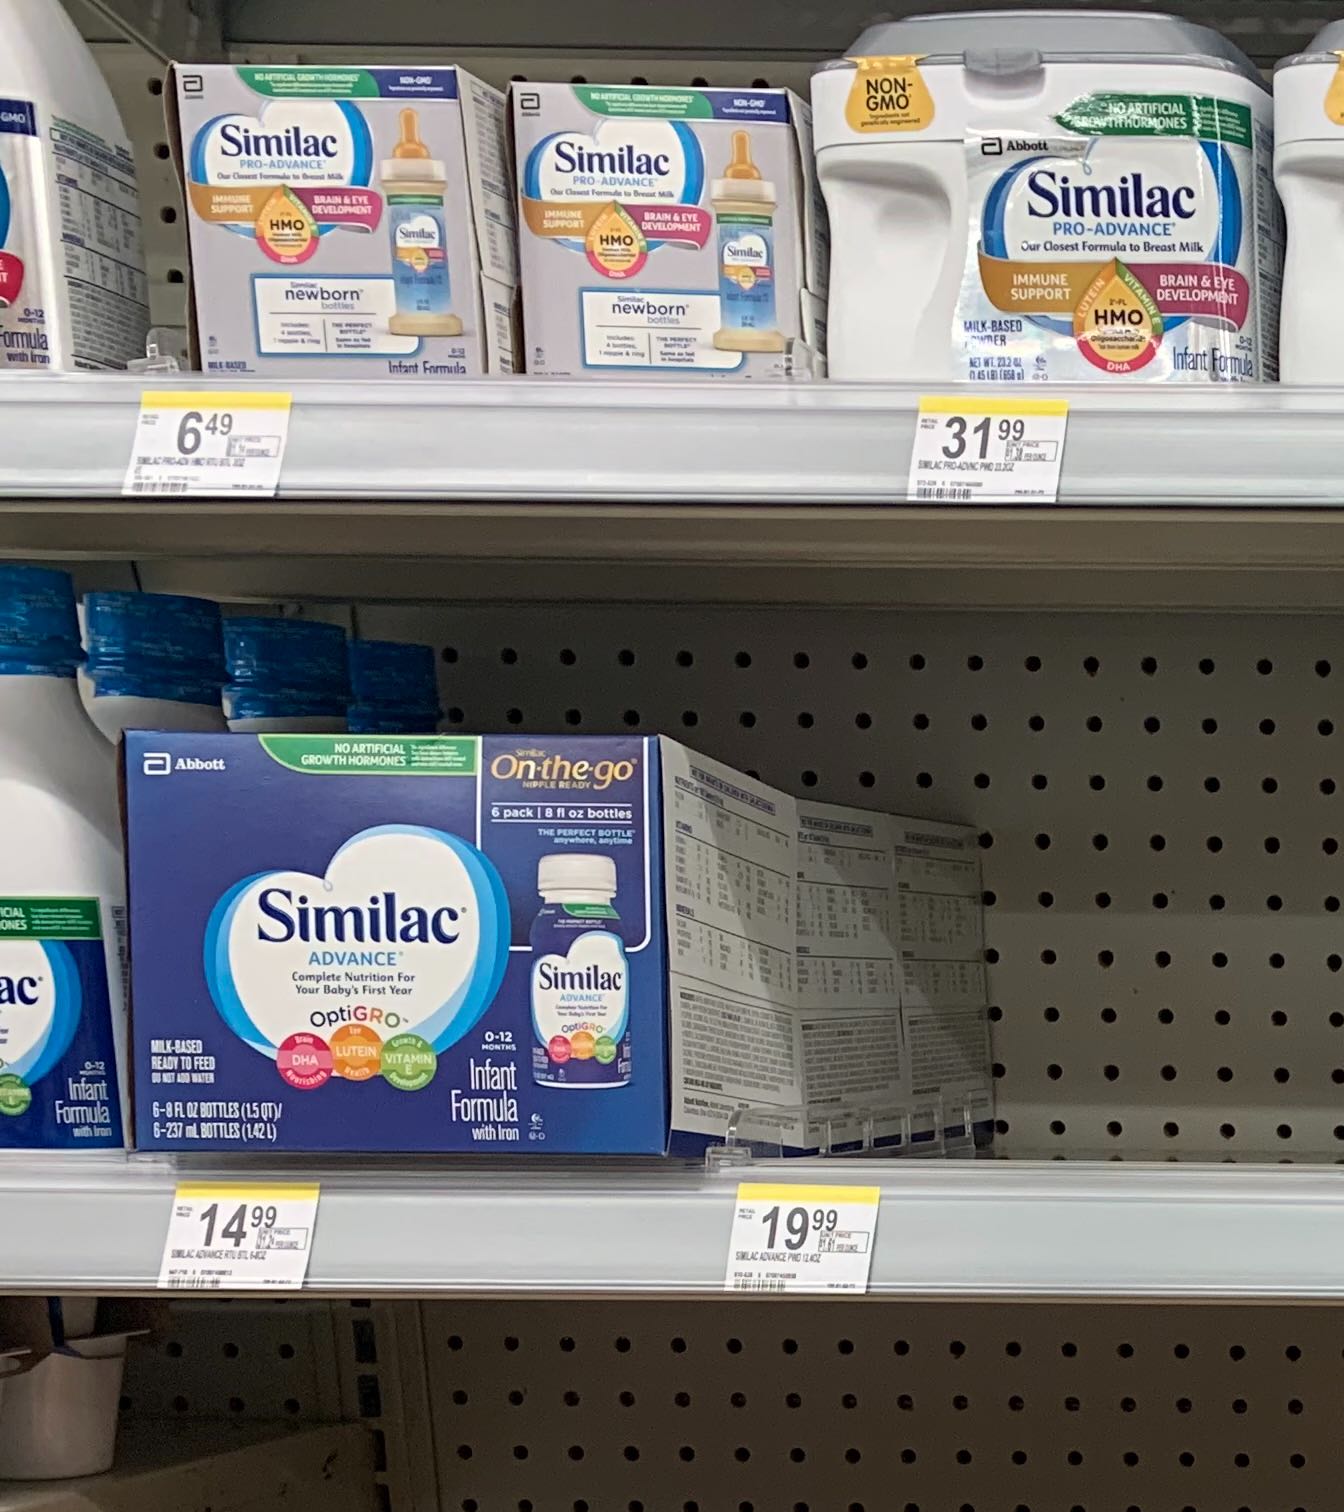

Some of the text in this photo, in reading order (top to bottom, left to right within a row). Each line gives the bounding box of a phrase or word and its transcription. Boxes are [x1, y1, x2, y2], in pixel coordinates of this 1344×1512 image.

[866, 78, 912, 95] NON-
[220, 124, 338, 159] Similac
[1007, 140, 1048, 152] Abbott
[240, 158, 325, 171] PRO-ADVANCE
[1028, 171, 1196, 219] Similac
[1054, 222, 1172, 237] PRO-ADVANCE
[599, 234, 634, 248] HMO
[1021, 240, 1203, 253] Our Closest Formula to Breast Milk
[1013, 274, 1068, 286] IMMUNE
[284, 287, 359, 303] newborn
[1011, 288, 1071, 300] SUPPORT
[1094, 310, 1143, 325] HMO
[1107, 361, 1131, 372] DHA
[175, 757, 225, 771] Abbott
[491, 806, 632, 821] 6 pack 8 fl oz bottles
[257, 889, 460, 944] Similac
[309, 951, 397, 967] ADVANCE
[296, 984, 413, 998] Your Baby's First Year
[470, 1060, 517, 1092] Infant
[451, 1092, 518, 1124] Formula
